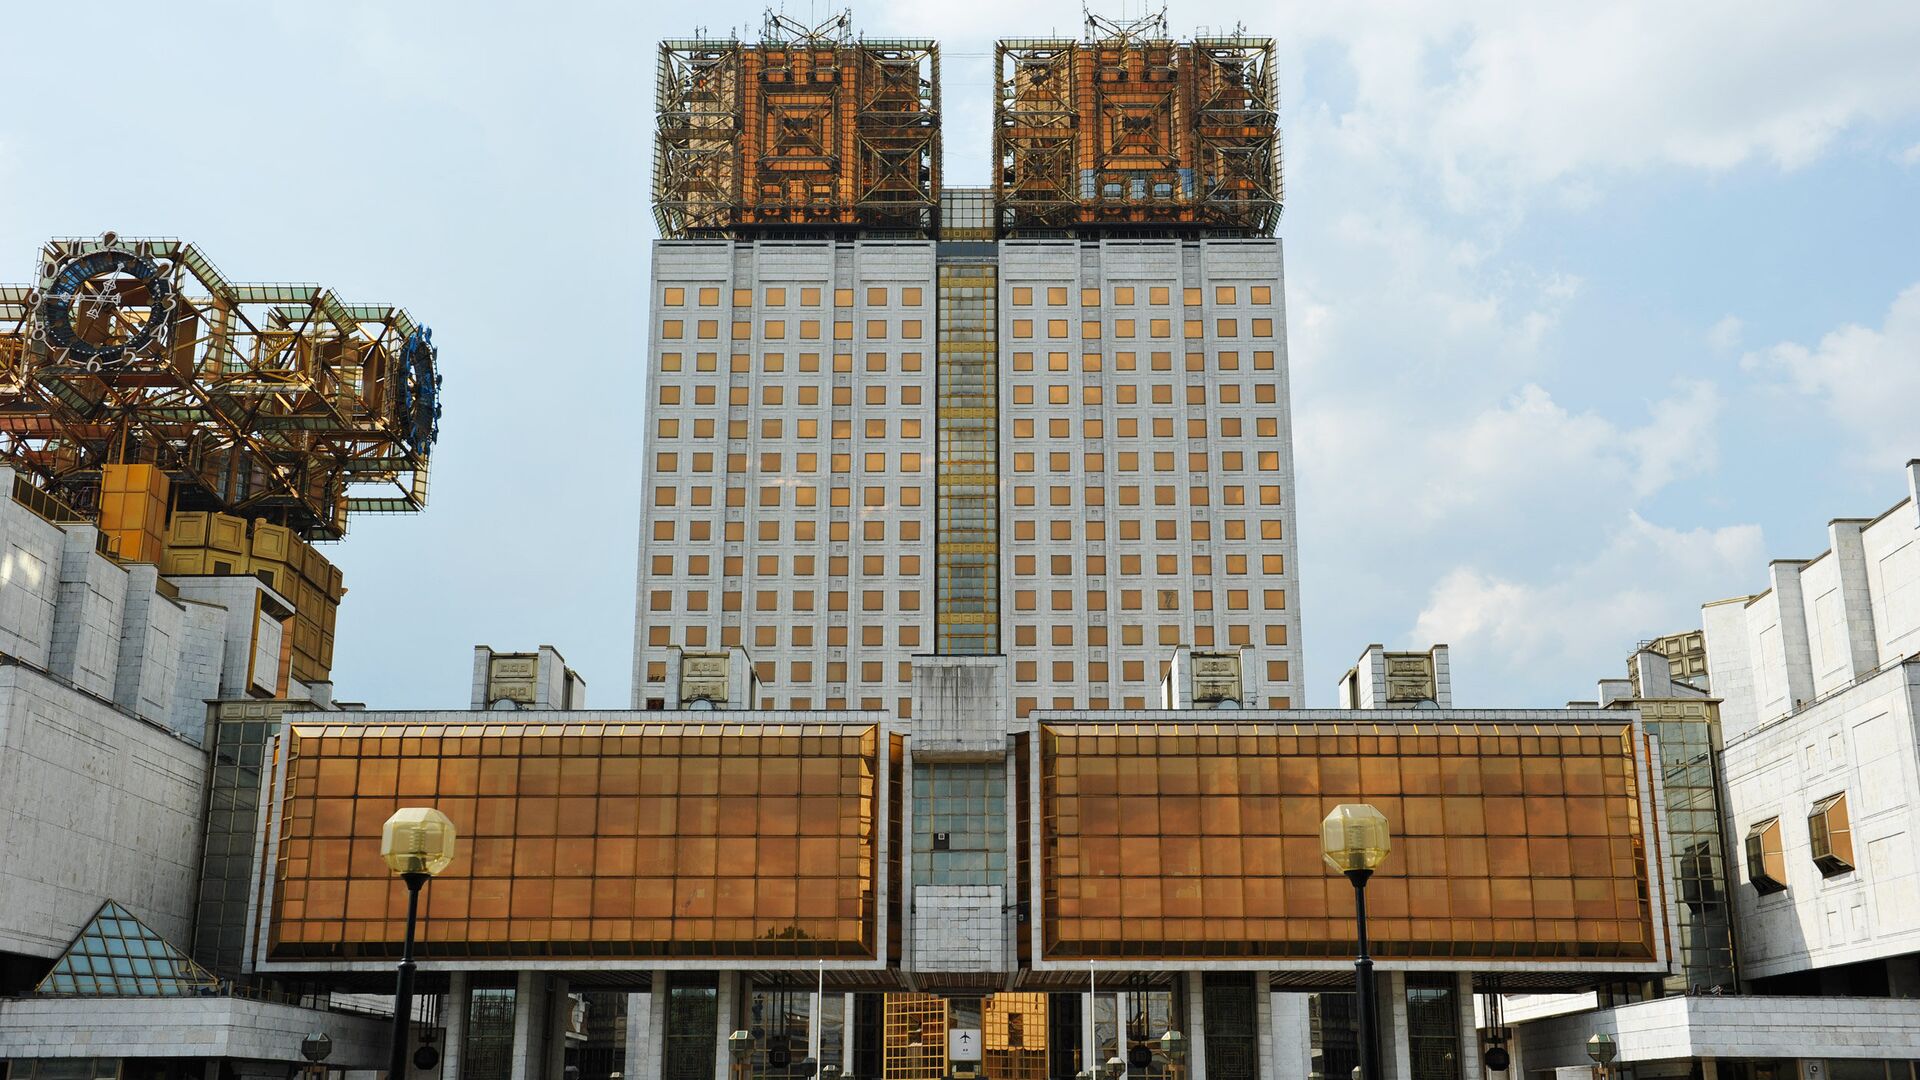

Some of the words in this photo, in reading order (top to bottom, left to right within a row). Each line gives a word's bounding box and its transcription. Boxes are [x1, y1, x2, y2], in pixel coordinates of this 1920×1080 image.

[66, 238, 83, 257] 11
[37, 262, 58, 279] 10
[159, 262, 173, 280] 2
[28, 292, 42, 312] 9
[162, 293, 177, 312] 3
[32, 321, 46, 341] 8
[149, 323, 163, 342] 4
[54, 345, 70, 365] 7
[86, 353, 103, 373] 6
[123, 346, 137, 367] 5
